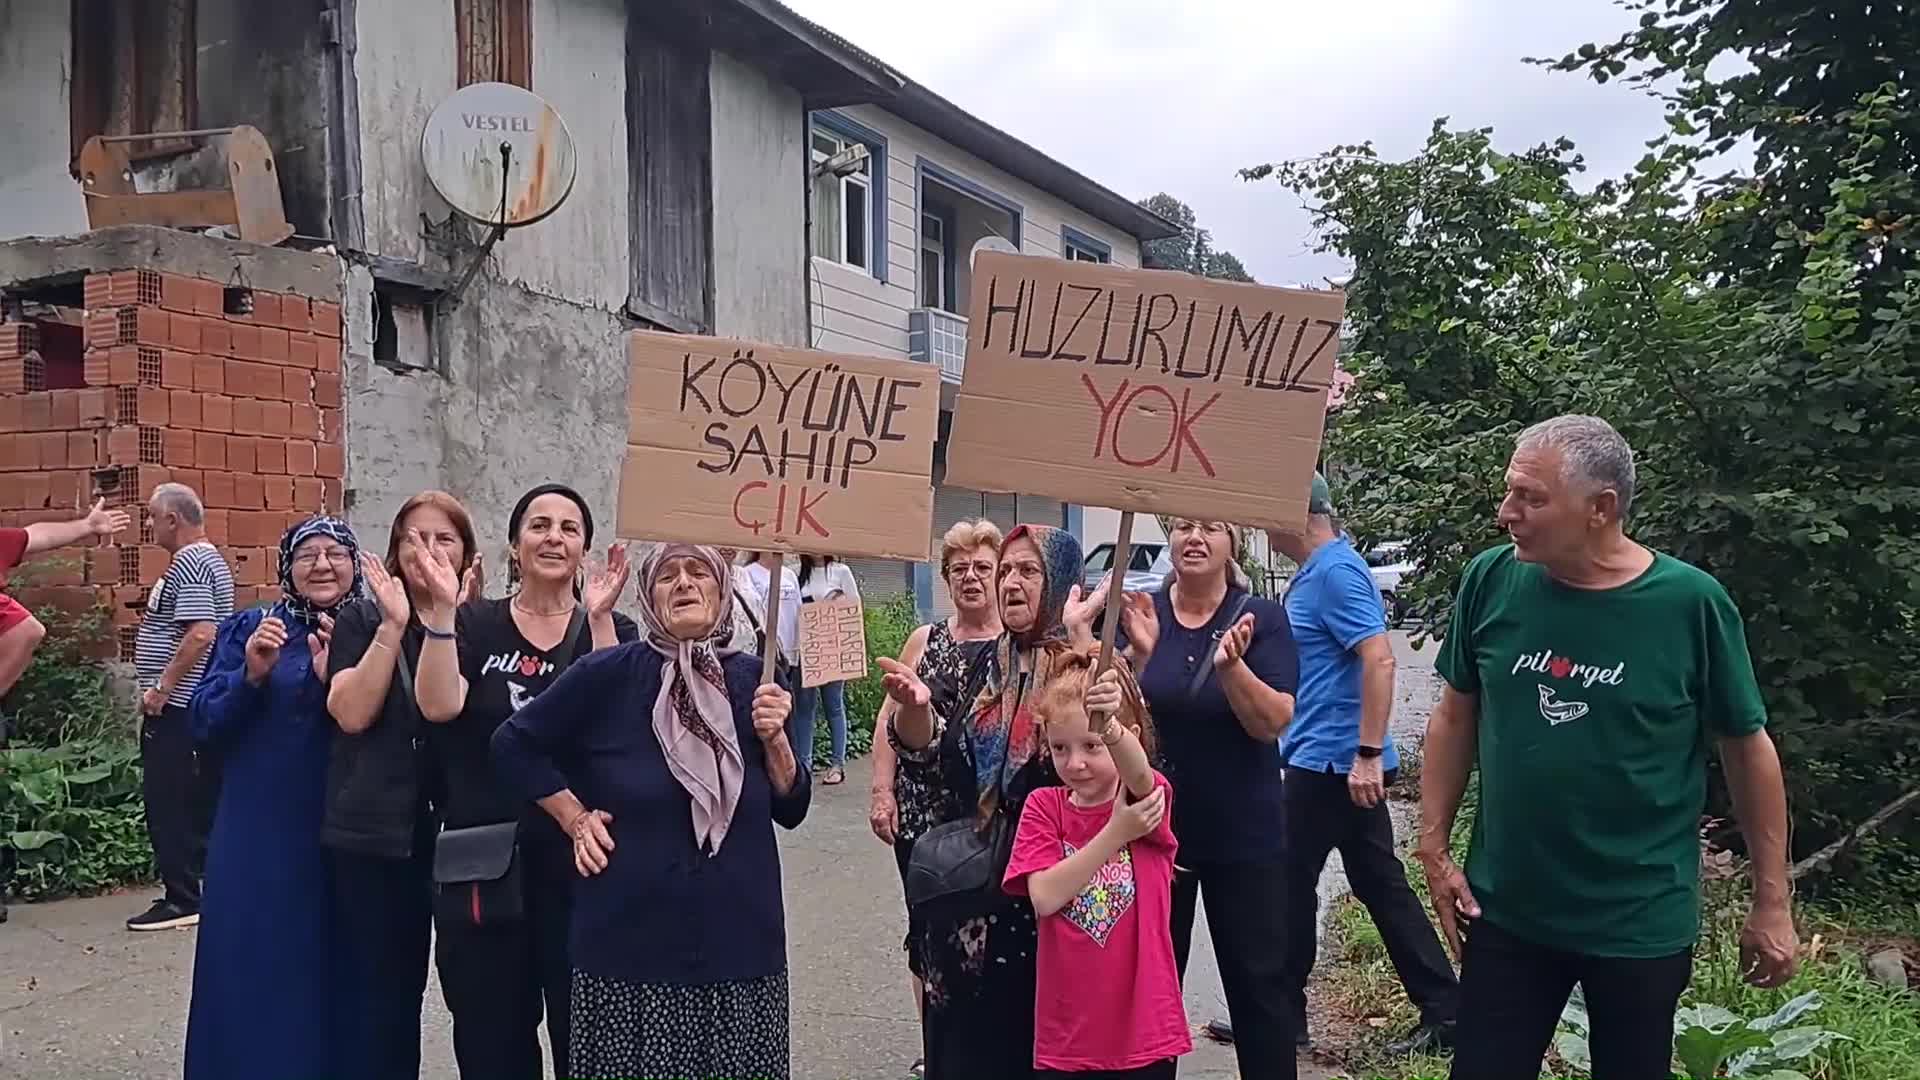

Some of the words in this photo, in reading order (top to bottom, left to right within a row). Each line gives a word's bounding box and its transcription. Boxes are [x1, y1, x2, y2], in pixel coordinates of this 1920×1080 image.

[461, 113, 535, 132] VESTEL
[983, 274, 1340, 393] HUZURUMUZ
[680, 348, 921, 441] KÖYÜNE
[1081, 373, 1222, 477] YOK
[733, 481, 829, 538] ÇIK
